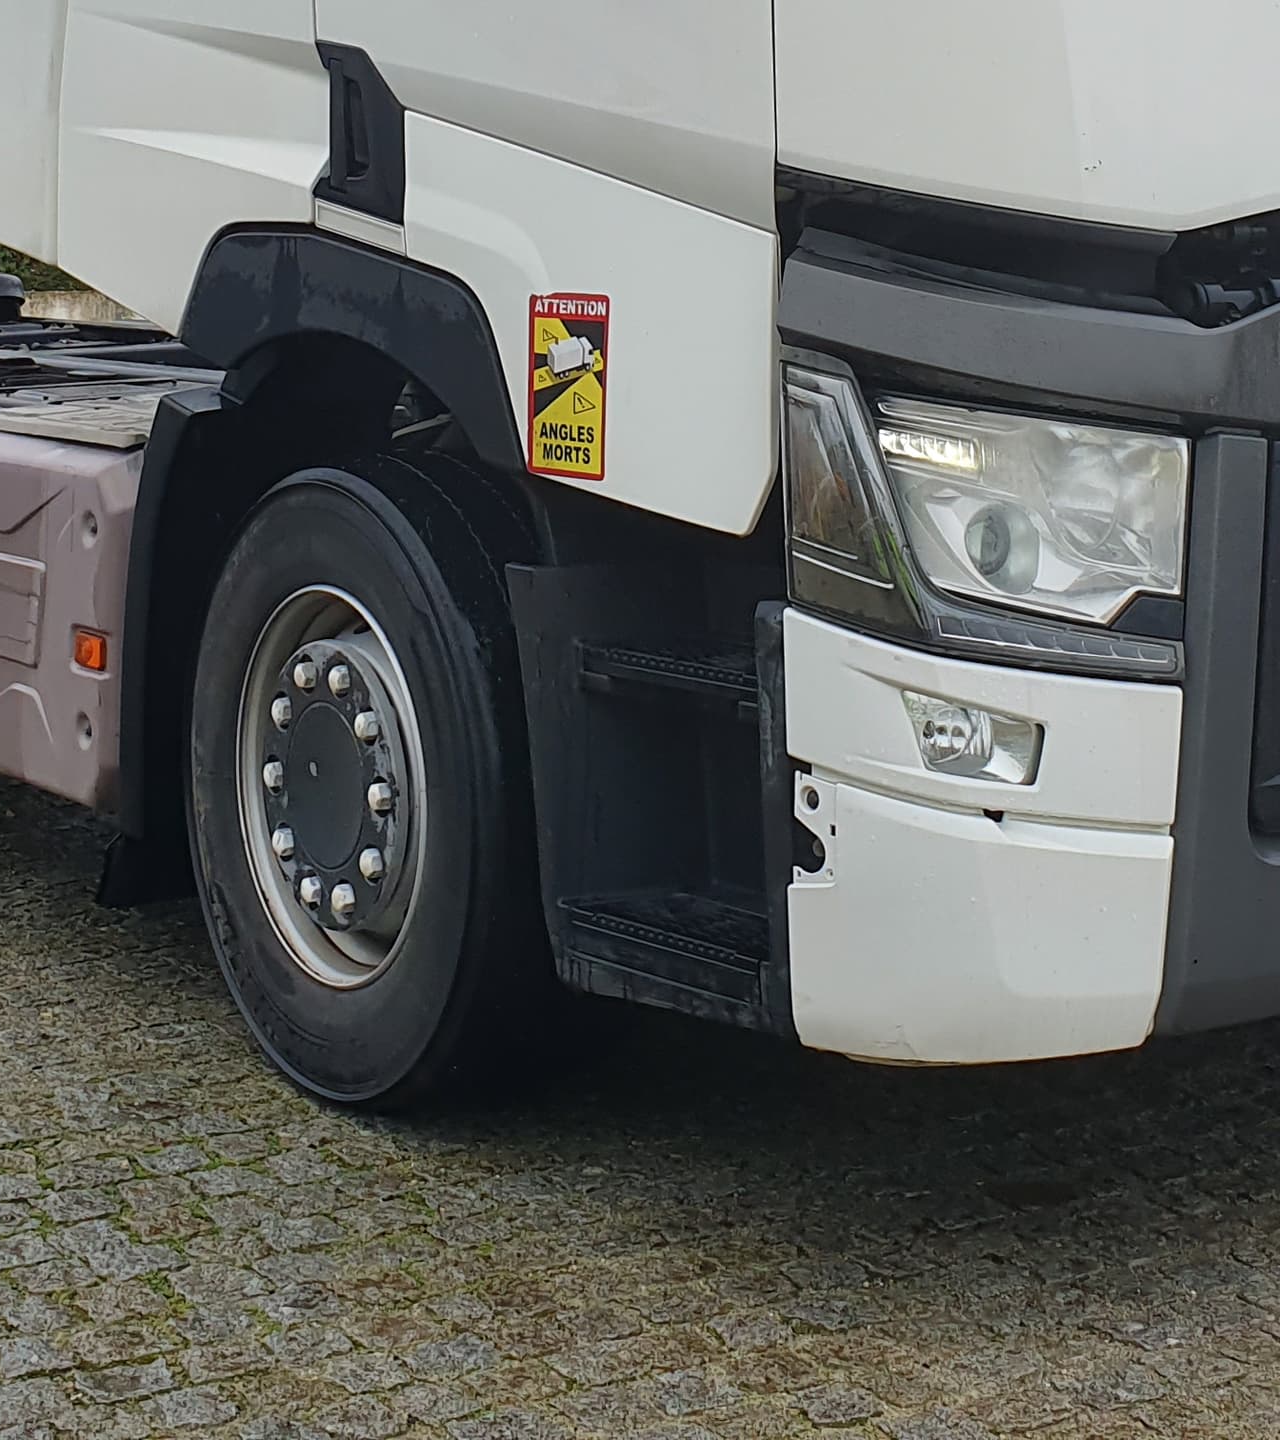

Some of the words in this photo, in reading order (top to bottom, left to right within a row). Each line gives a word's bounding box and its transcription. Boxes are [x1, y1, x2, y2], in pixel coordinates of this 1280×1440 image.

[534, 298, 606, 316] ATTENTION
[539, 422, 595, 444] ANGLES
[542, 443, 591, 465] MORTS
